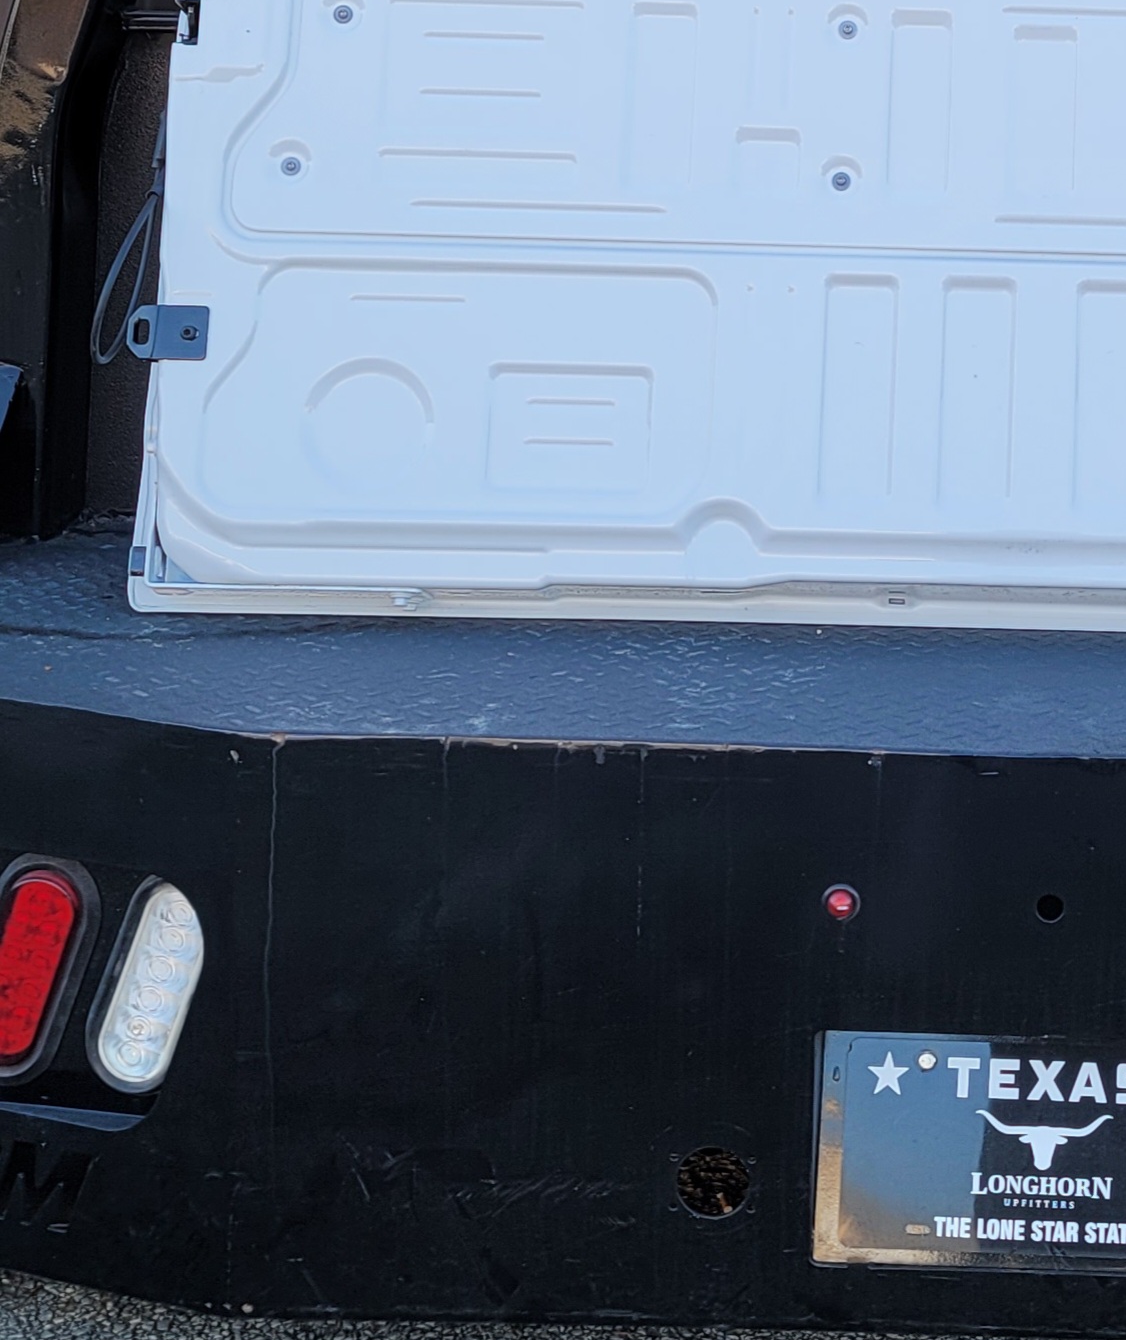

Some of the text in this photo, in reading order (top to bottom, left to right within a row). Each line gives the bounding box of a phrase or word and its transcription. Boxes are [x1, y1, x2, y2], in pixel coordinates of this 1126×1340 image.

[970, 1171, 1113, 1200] LONGHORN
[1003, 1198, 1075, 1210] UPFITTERS
[934, 1216, 972, 1239] THE
[977, 1218, 1026, 1241] LONE
[1031, 1220, 1079, 1243] STAR
